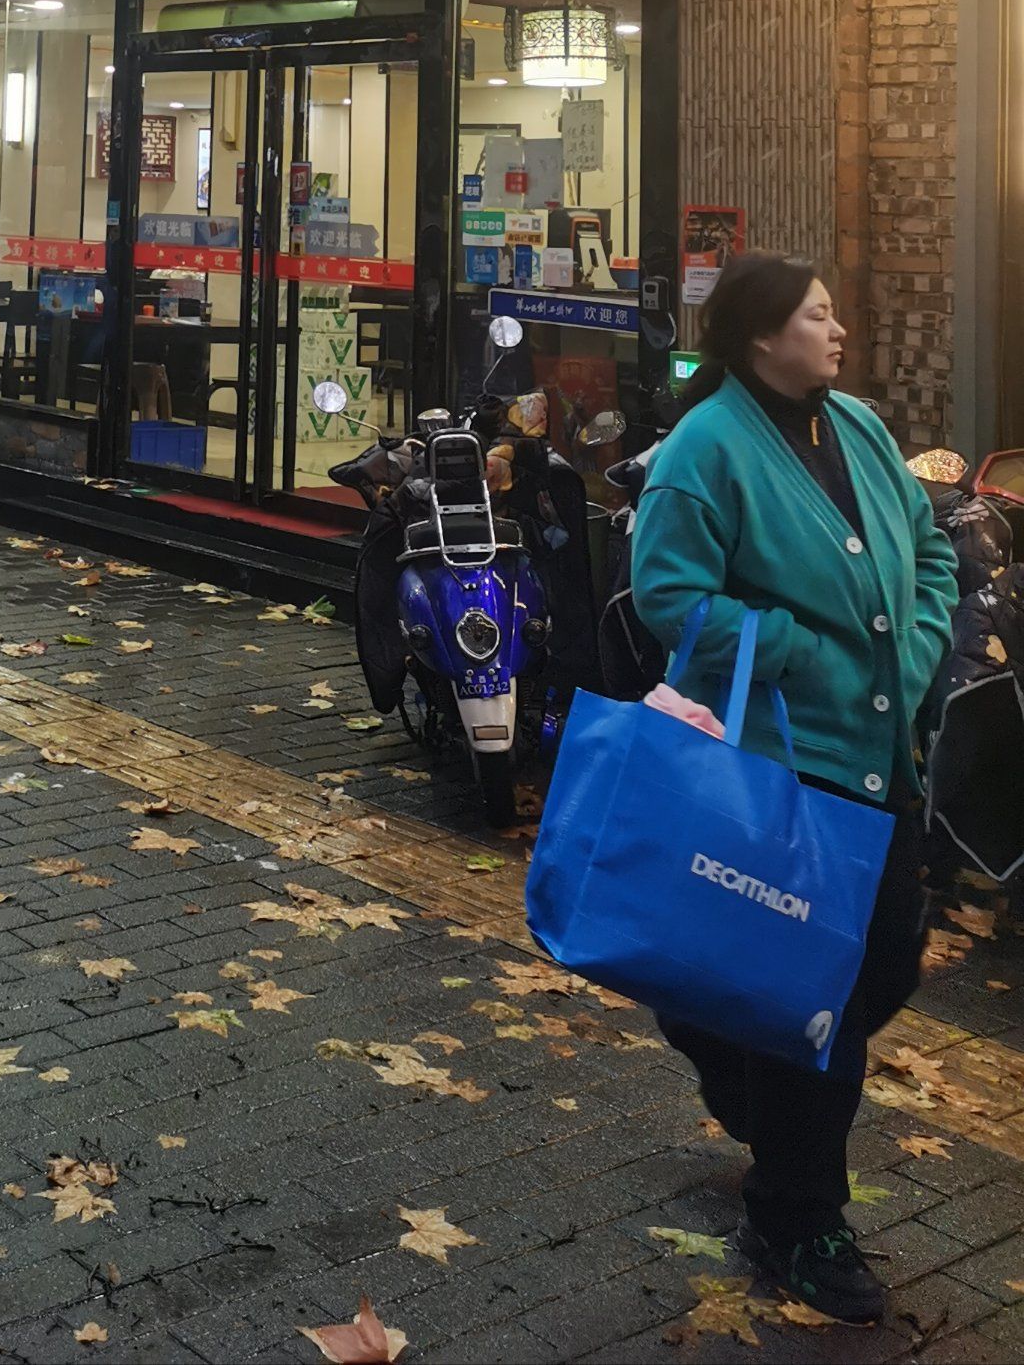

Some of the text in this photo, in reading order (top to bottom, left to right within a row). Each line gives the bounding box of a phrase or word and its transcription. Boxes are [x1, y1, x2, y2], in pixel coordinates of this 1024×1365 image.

[144, 220, 192, 238] 欢迎光临
[310, 229, 362, 250] 欢迎光临
[584, 306, 628, 325] 欢迎您
[690, 852, 811, 923] DECATHLON
